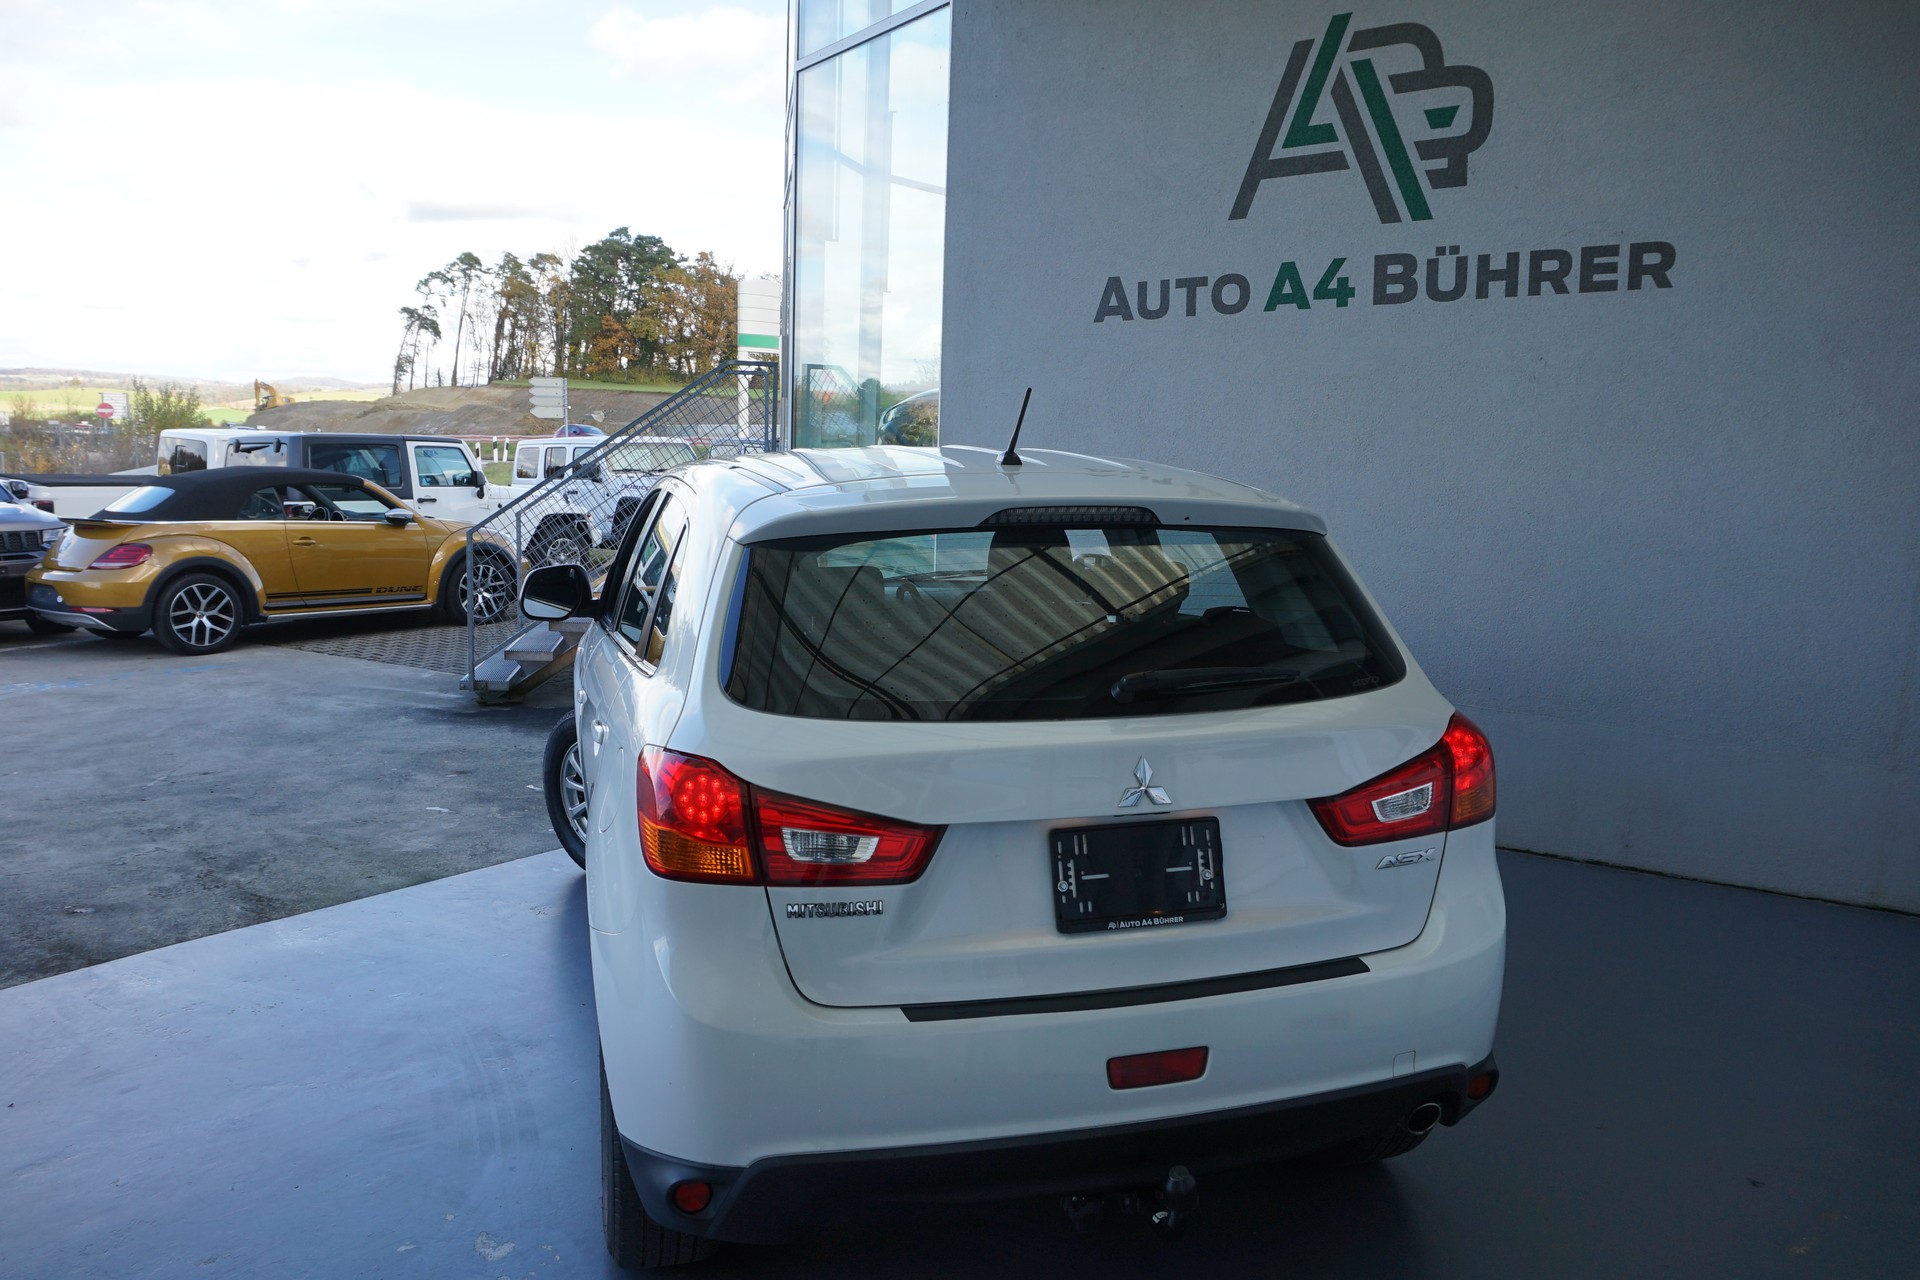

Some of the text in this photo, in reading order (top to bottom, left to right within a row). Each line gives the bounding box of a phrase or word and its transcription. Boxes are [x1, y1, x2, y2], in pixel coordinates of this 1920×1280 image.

[1093, 240, 1678, 324] AUTO A4 BÜHRER
[375, 585, 424, 593] DUNE
[1375, 847, 1436, 870] ASX
[786, 900, 884, 919] MITSUBISHI
[1119, 920, 1141, 929] AUTO
[1141, 918, 1153, 927] A4
[1153, 916, 1184, 925] BÜHRER
